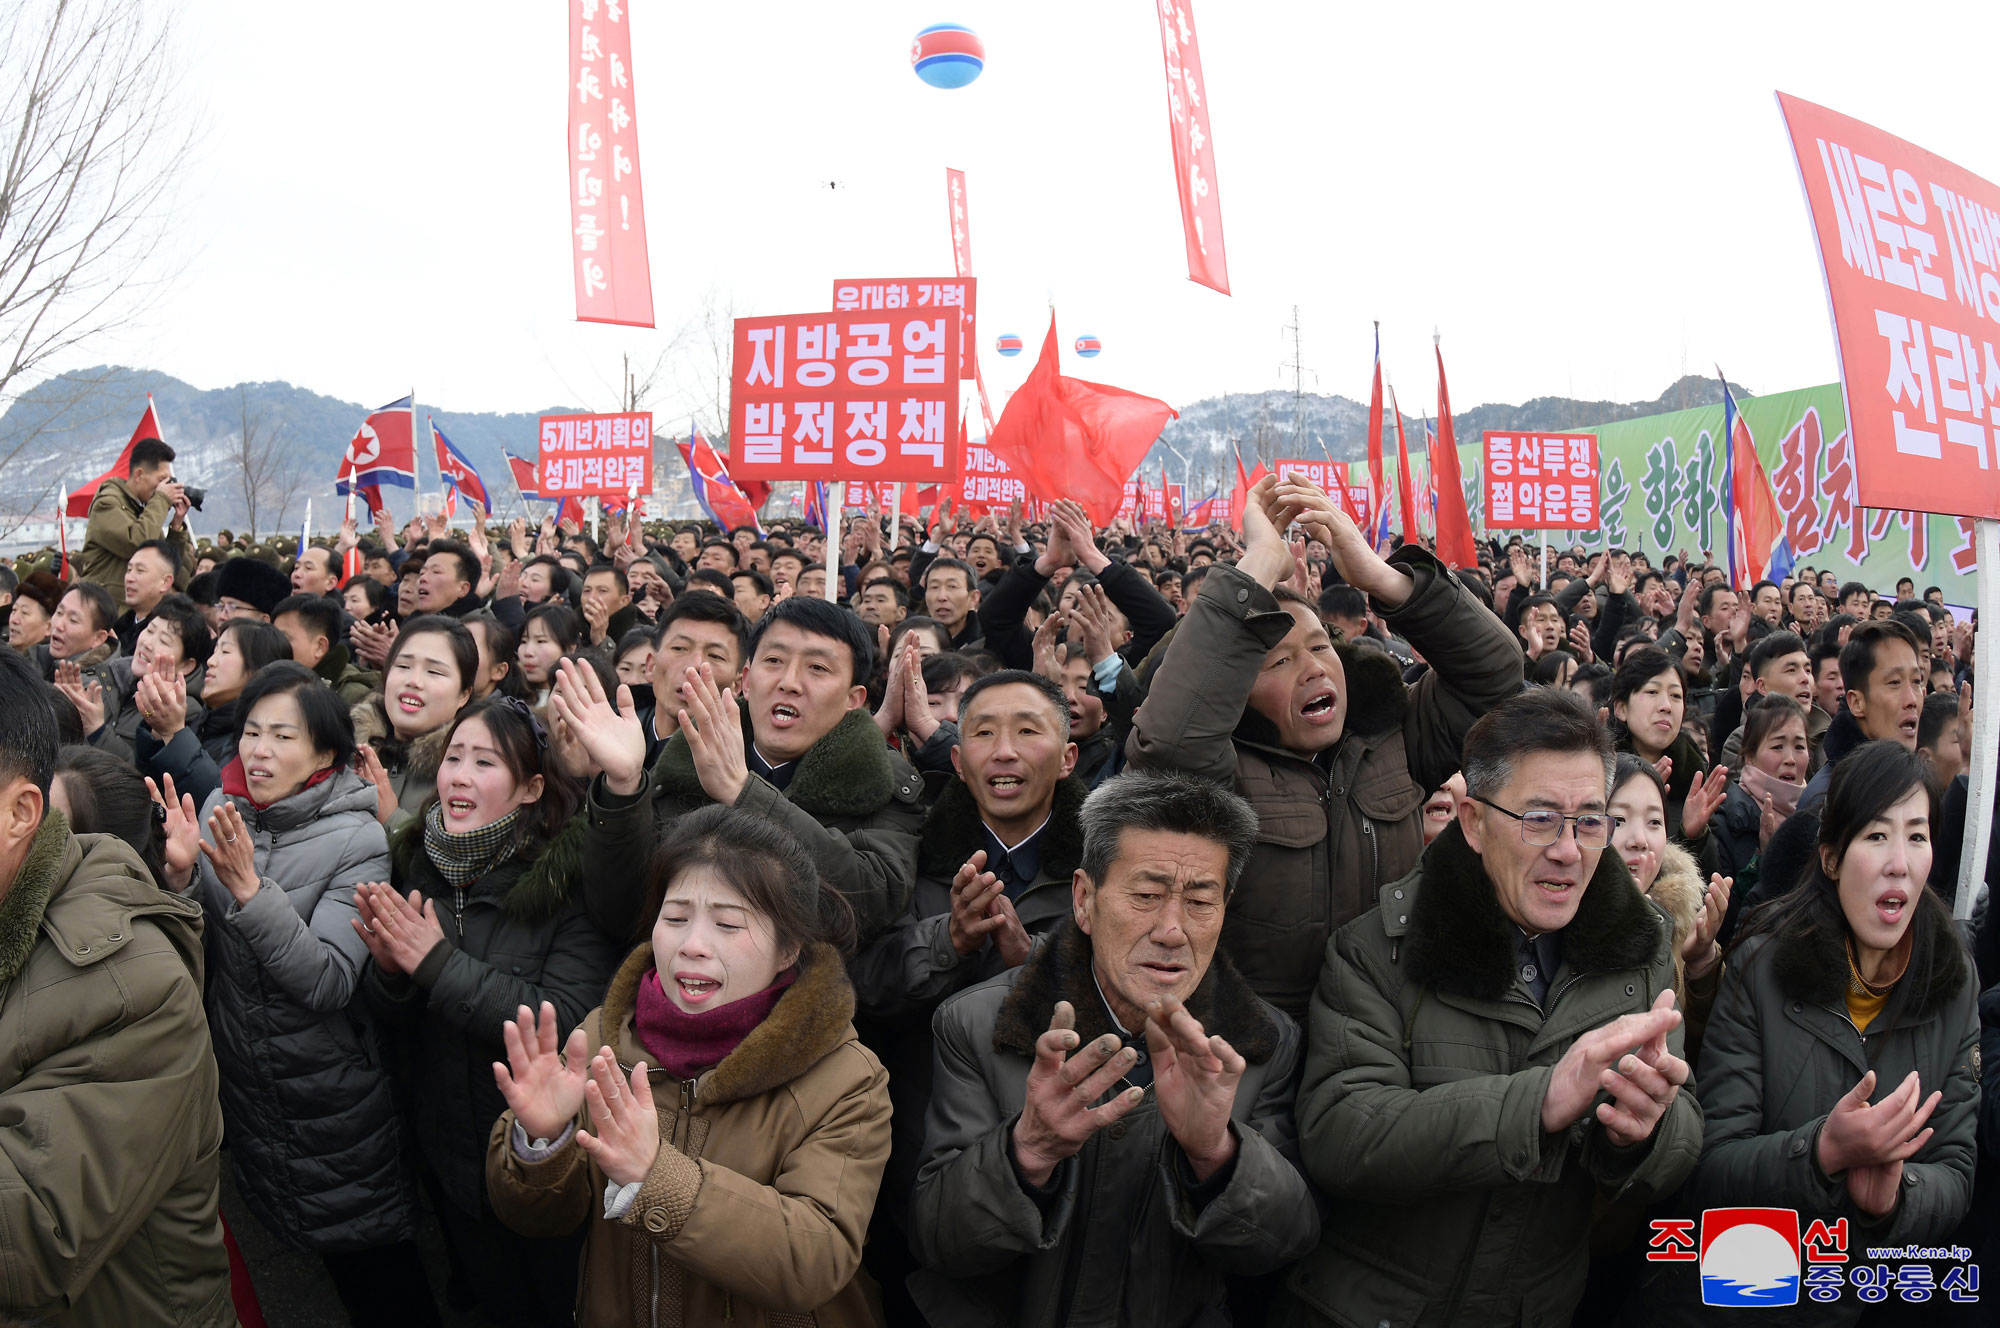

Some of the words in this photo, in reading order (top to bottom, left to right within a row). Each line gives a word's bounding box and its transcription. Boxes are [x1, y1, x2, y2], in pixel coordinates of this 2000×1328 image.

[1816, 138, 1947, 301] 새로운
[1928, 181, 2000, 325] 지방
[745, 319, 946, 388] 지방공업
[541, 418, 650, 453] 5개년계획의
[744, 398, 945, 467] 발전정책
[1489, 436, 1597, 479] 증산투쟁,
[545, 456, 645, 491] 성과적완결
[1641, 431, 1730, 552] 향하
[1491, 482, 1593, 523] 절약운동
